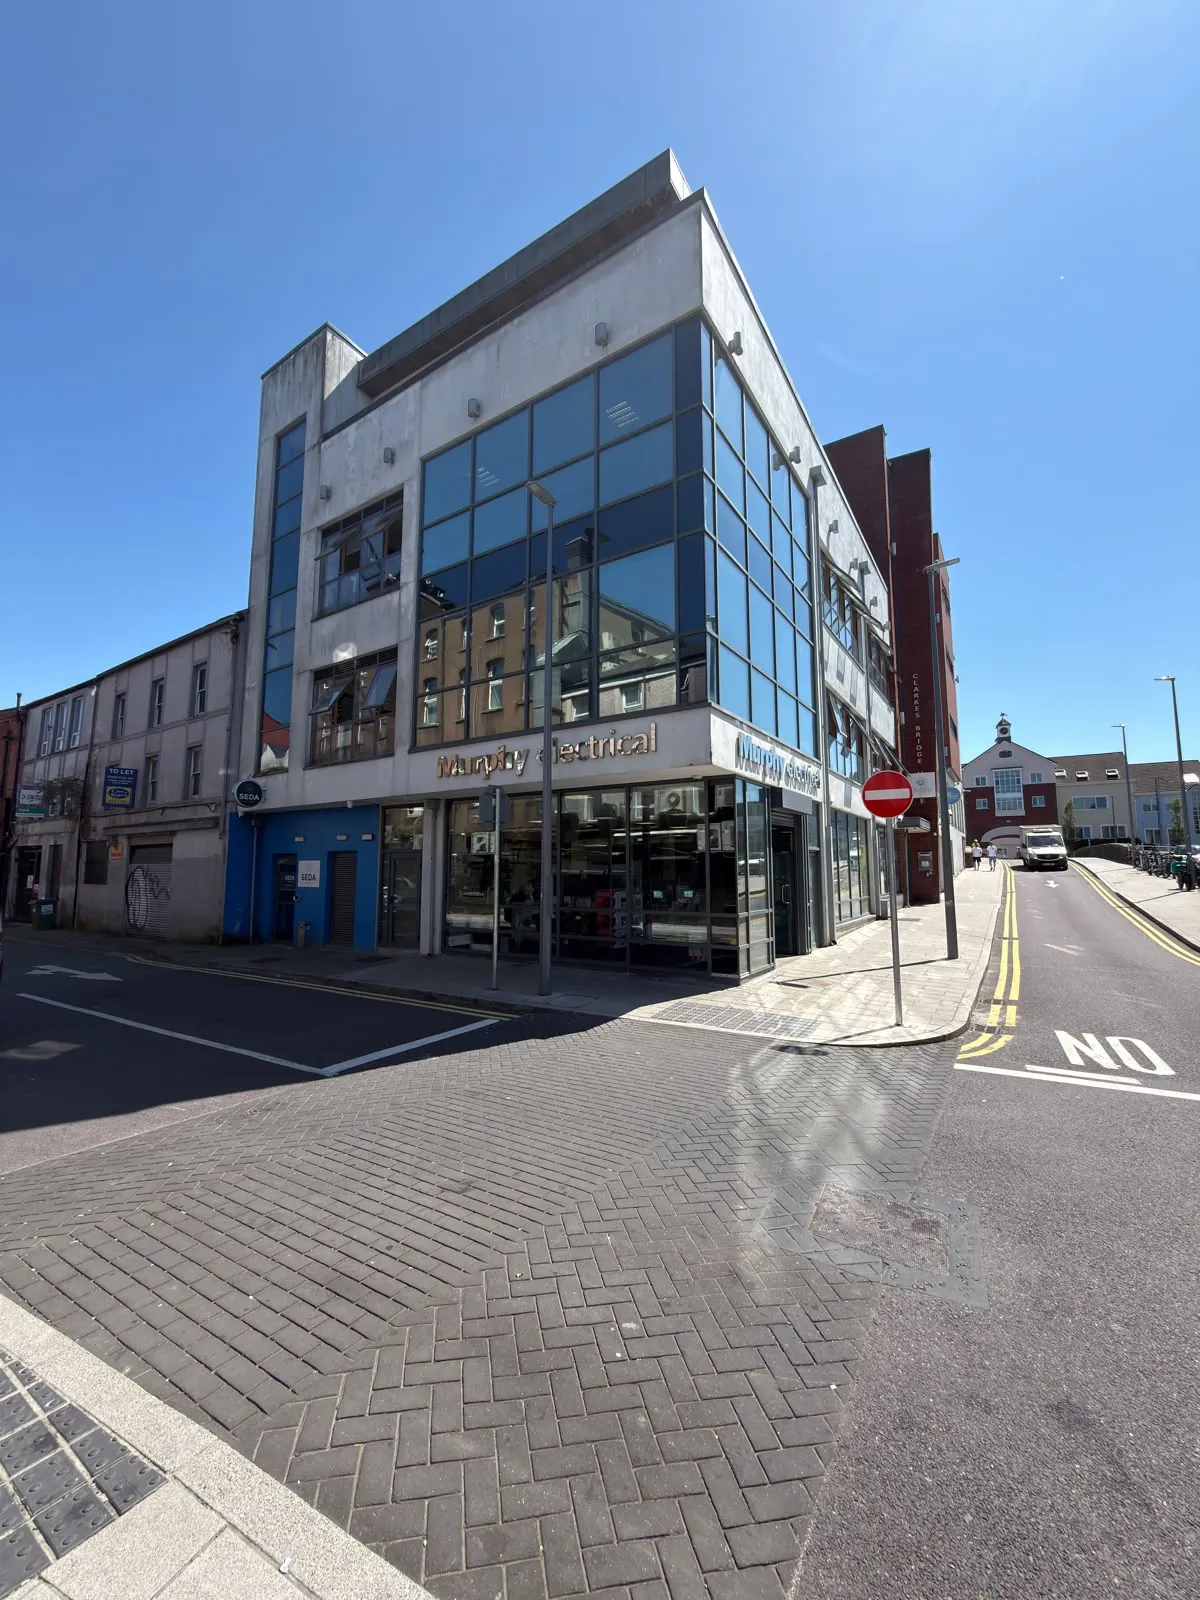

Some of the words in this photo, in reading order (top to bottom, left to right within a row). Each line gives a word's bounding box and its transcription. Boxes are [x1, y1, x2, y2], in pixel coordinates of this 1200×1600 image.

[912, 673, 921, 719] CLARKES
[436, 745, 529, 780] Murphy
[738, 732, 786, 780] Murphy
[915, 725, 923, 764] BRIDGE
[239, 793, 259, 801] SEDA
[300, 873, 316, 881] SEDA
[1053, 1030, 1176, 1076] NO
